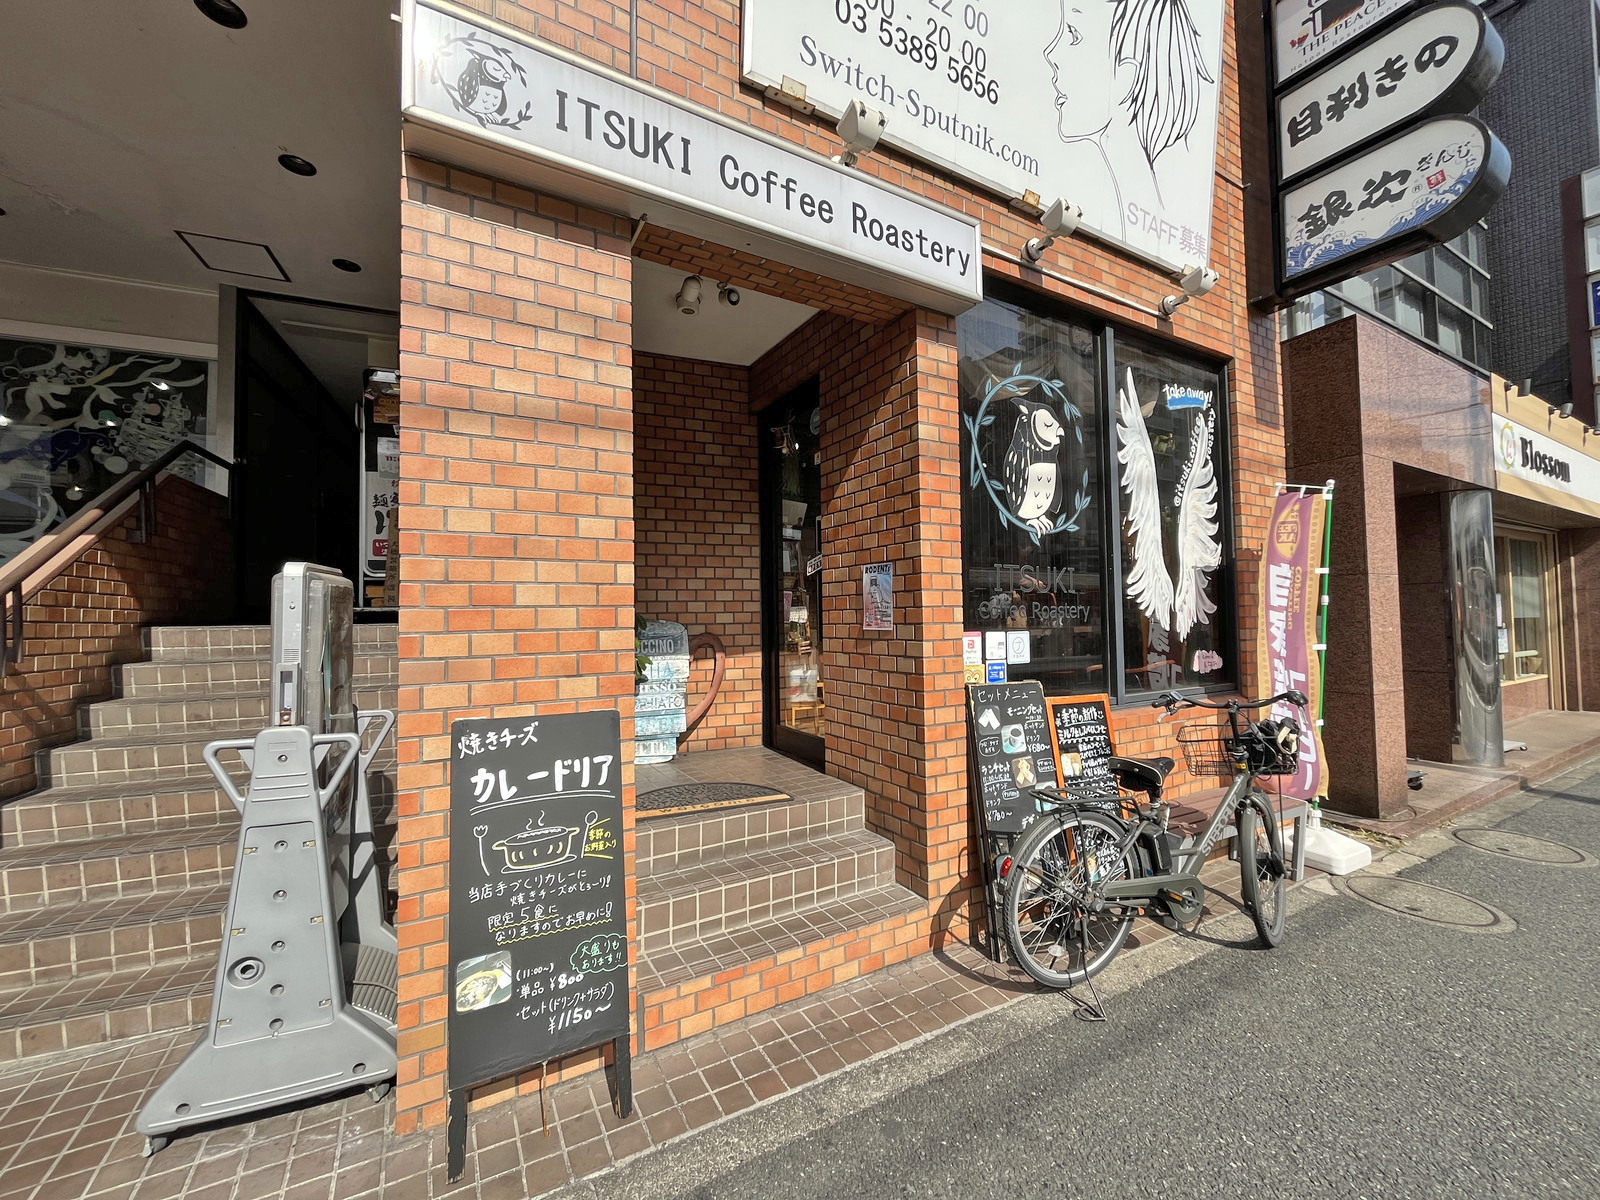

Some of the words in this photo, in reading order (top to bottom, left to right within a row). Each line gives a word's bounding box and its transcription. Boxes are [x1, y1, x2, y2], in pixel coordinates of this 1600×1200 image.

[964, 5, 988, 38] 00
[835, 0, 867, 33] 03
[878, 17, 937, 71] 5389
[947, 56, 999, 105] 5656
[925, 17, 951, 53] 20
[962, 40, 986, 73] 00
[1299, 34, 1330, 56] THE
[799, 35, 1040, 178] Switch-Sputnik.com
[1287, 36, 1459, 147] 目利きの
[555, 88, 692, 176] ITSUKI
[719, 153, 834, 224] Coffee
[851, 200, 971, 278] Roastery
[1162, 383, 1186, 400] take
[1519, 436, 1571, 484] Blossom
[993, 563, 1077, 593] ITSUKI
[979, 600, 1027, 619] Coffee
[1031, 601, 1090, 622] Roastery
[977, 688, 1036, 703] セットメニュー
[457, 721, 539, 759] 焼きチーズ
[470, 754, 614, 803] カレードリア
